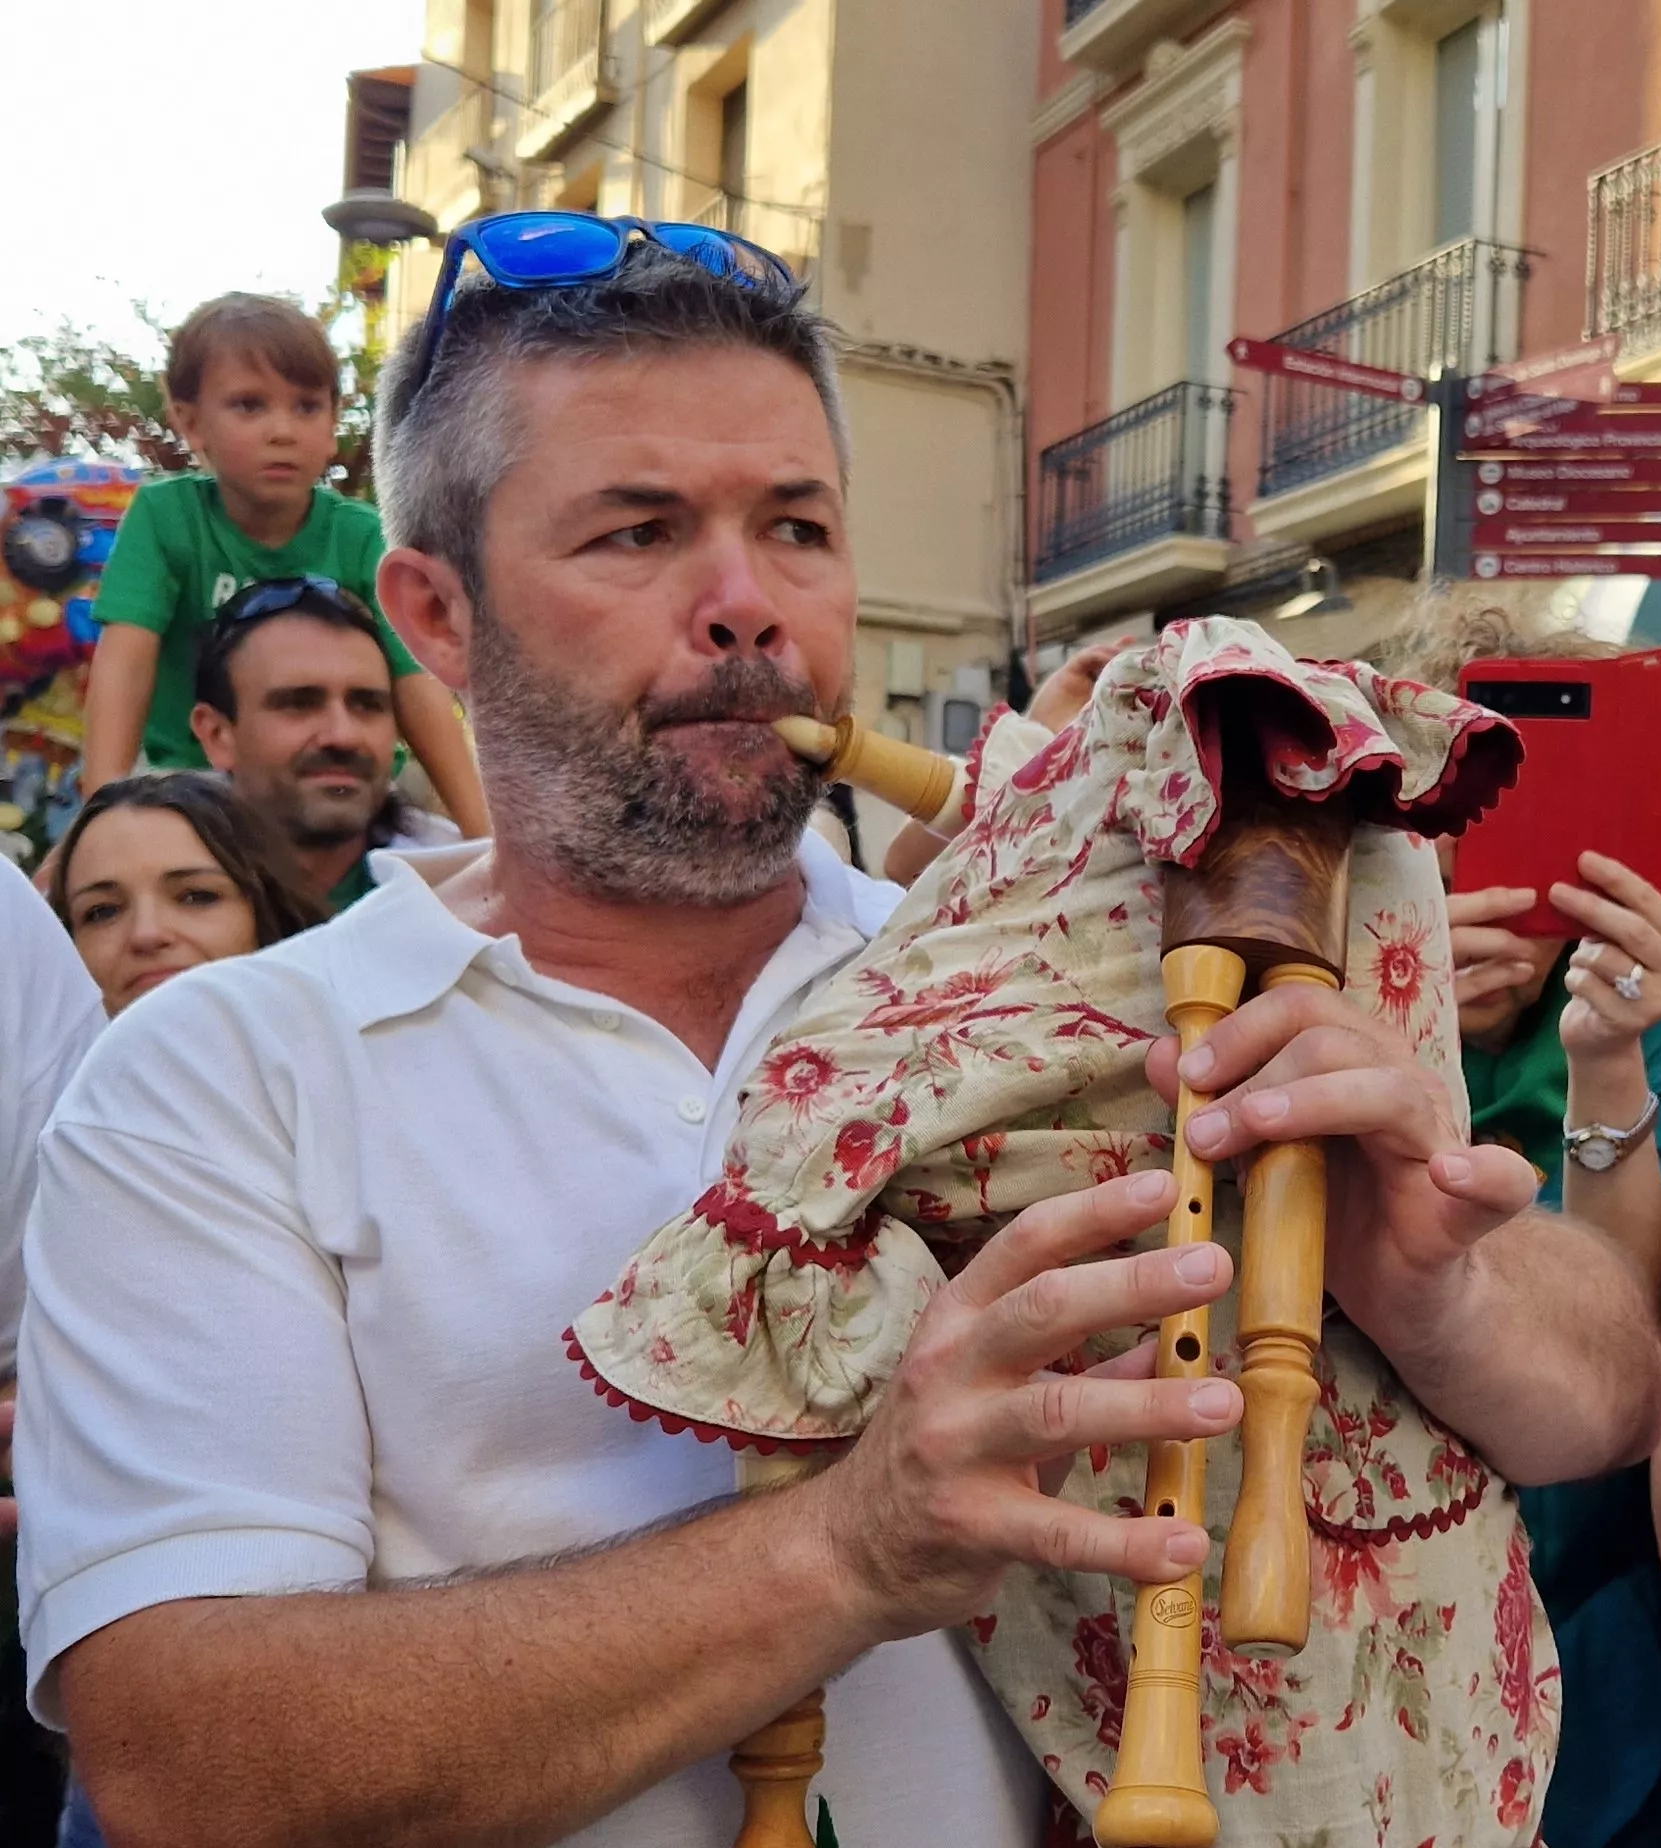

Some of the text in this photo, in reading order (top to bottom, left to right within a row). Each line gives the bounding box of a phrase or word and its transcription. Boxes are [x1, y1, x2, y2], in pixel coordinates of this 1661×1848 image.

[1507, 465, 1554, 479] Museo
[1505, 495, 1566, 511] Catedral
[1506, 528, 1602, 544] Ayuntamiento
[1504, 559, 1551, 573] Centro
